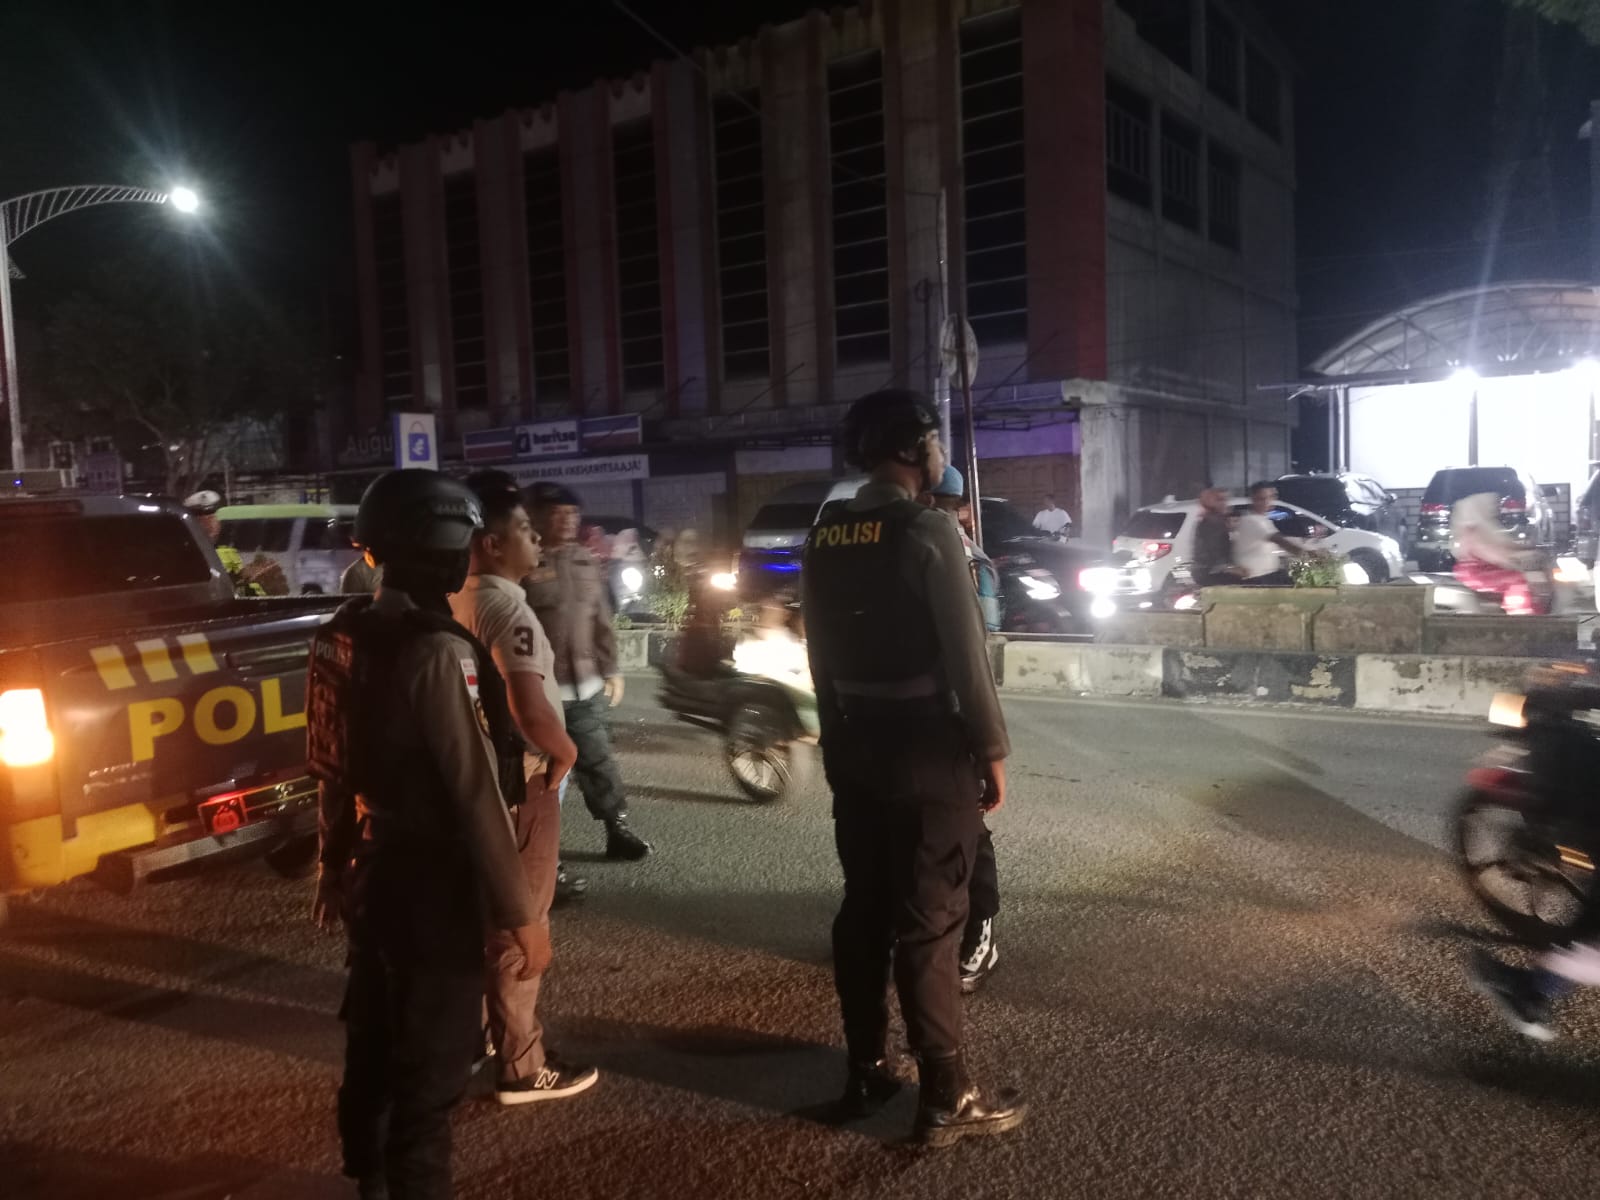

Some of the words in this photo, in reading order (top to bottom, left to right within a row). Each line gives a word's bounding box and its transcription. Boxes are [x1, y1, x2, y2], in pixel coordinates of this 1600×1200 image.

[815, 521, 882, 548] POLISI
[513, 626, 534, 656] 3
[128, 677, 308, 763] POL
